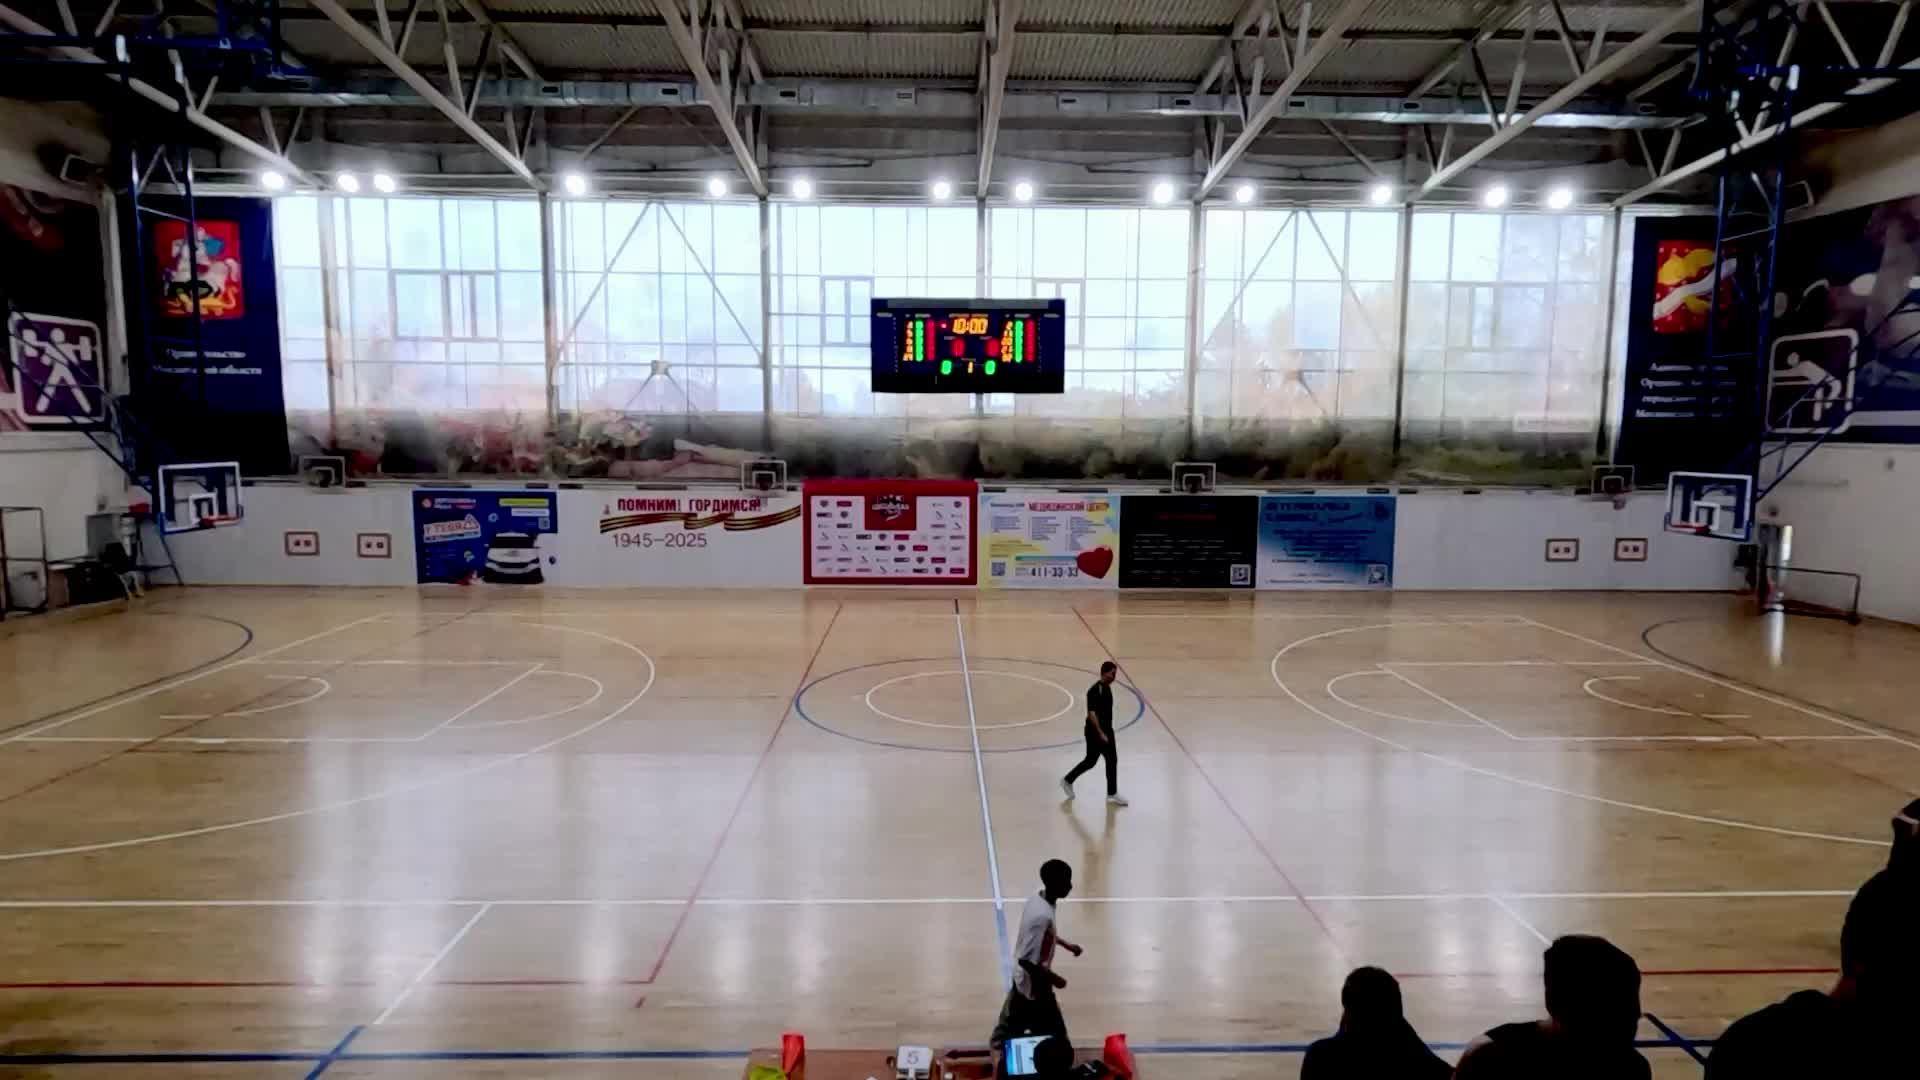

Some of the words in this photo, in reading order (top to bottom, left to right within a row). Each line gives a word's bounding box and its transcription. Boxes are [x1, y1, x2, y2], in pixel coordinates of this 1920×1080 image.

[952, 318, 988, 334] 10:00
[617, 498, 682, 512] ПОМНИМ!
[689, 498, 763, 513] ГОРДИМСЯ!
[907, 1050, 919, 1065] 5
